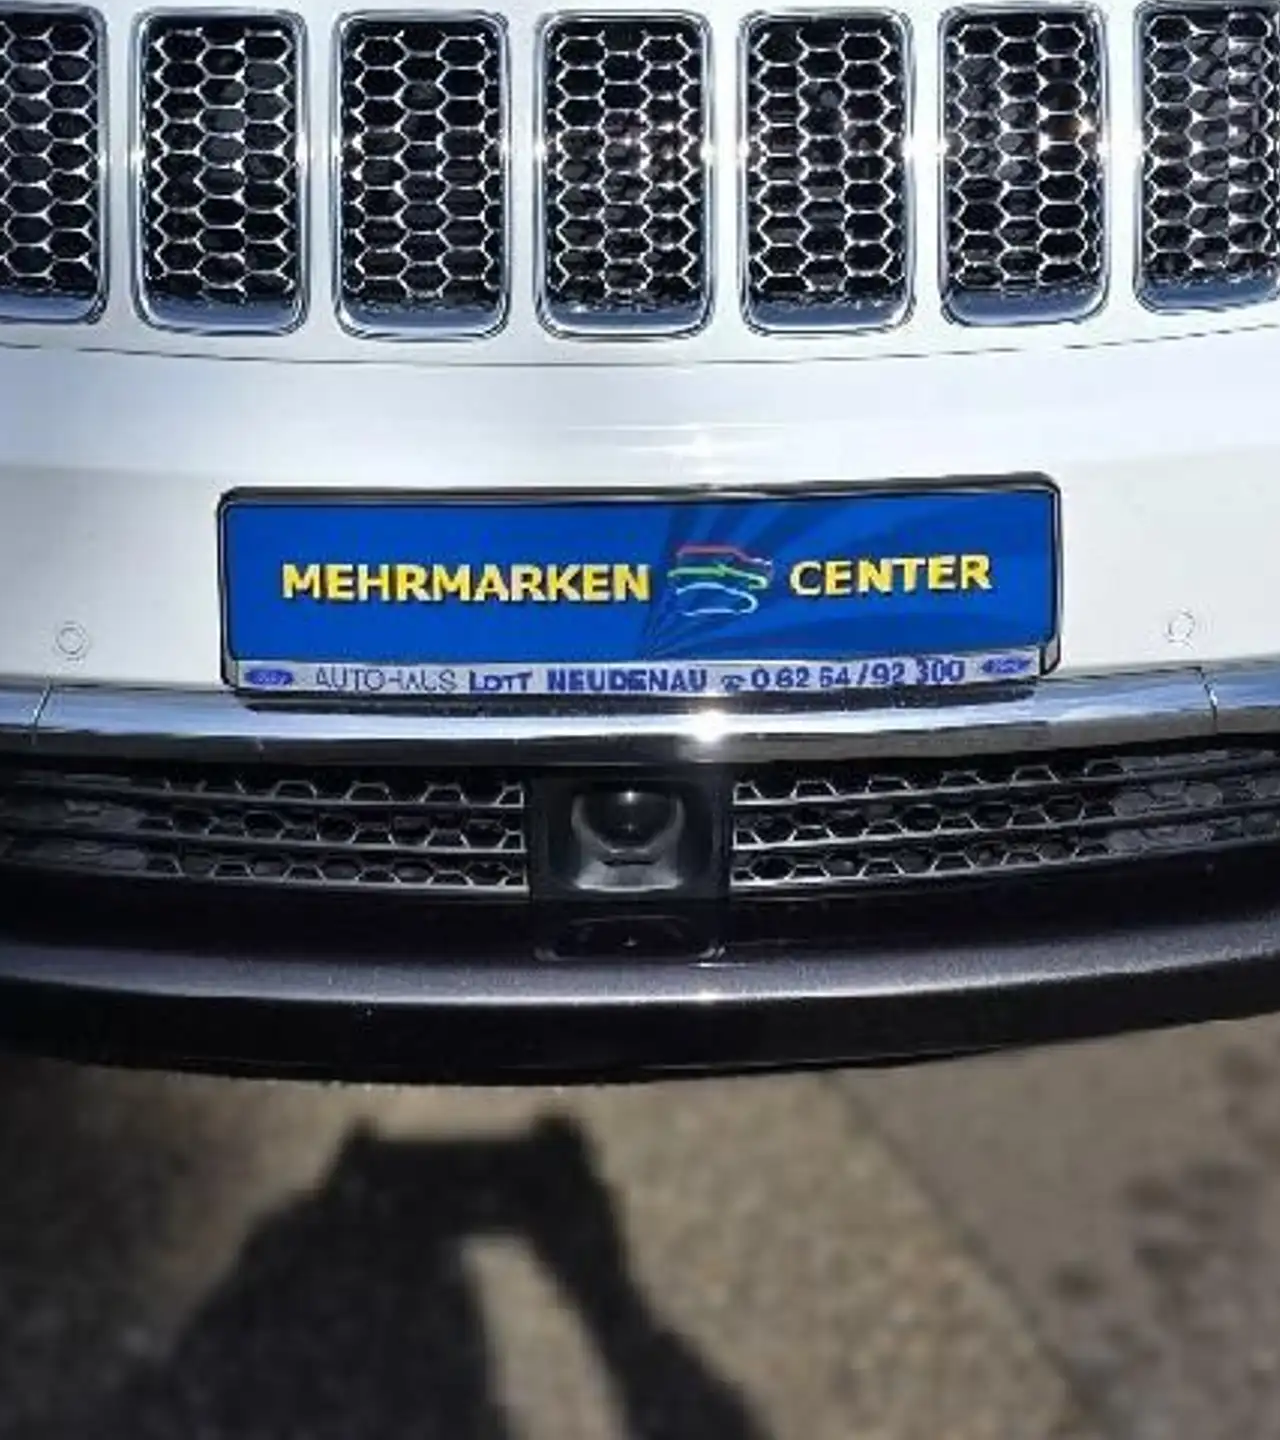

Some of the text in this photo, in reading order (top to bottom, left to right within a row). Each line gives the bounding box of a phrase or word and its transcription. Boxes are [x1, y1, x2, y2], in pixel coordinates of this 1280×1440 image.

[281, 554, 993, 603] MEHRMARKEN CENTER
[468, 669, 534, 691] LOTT
[547, 668, 708, 693] NEUDENAU
